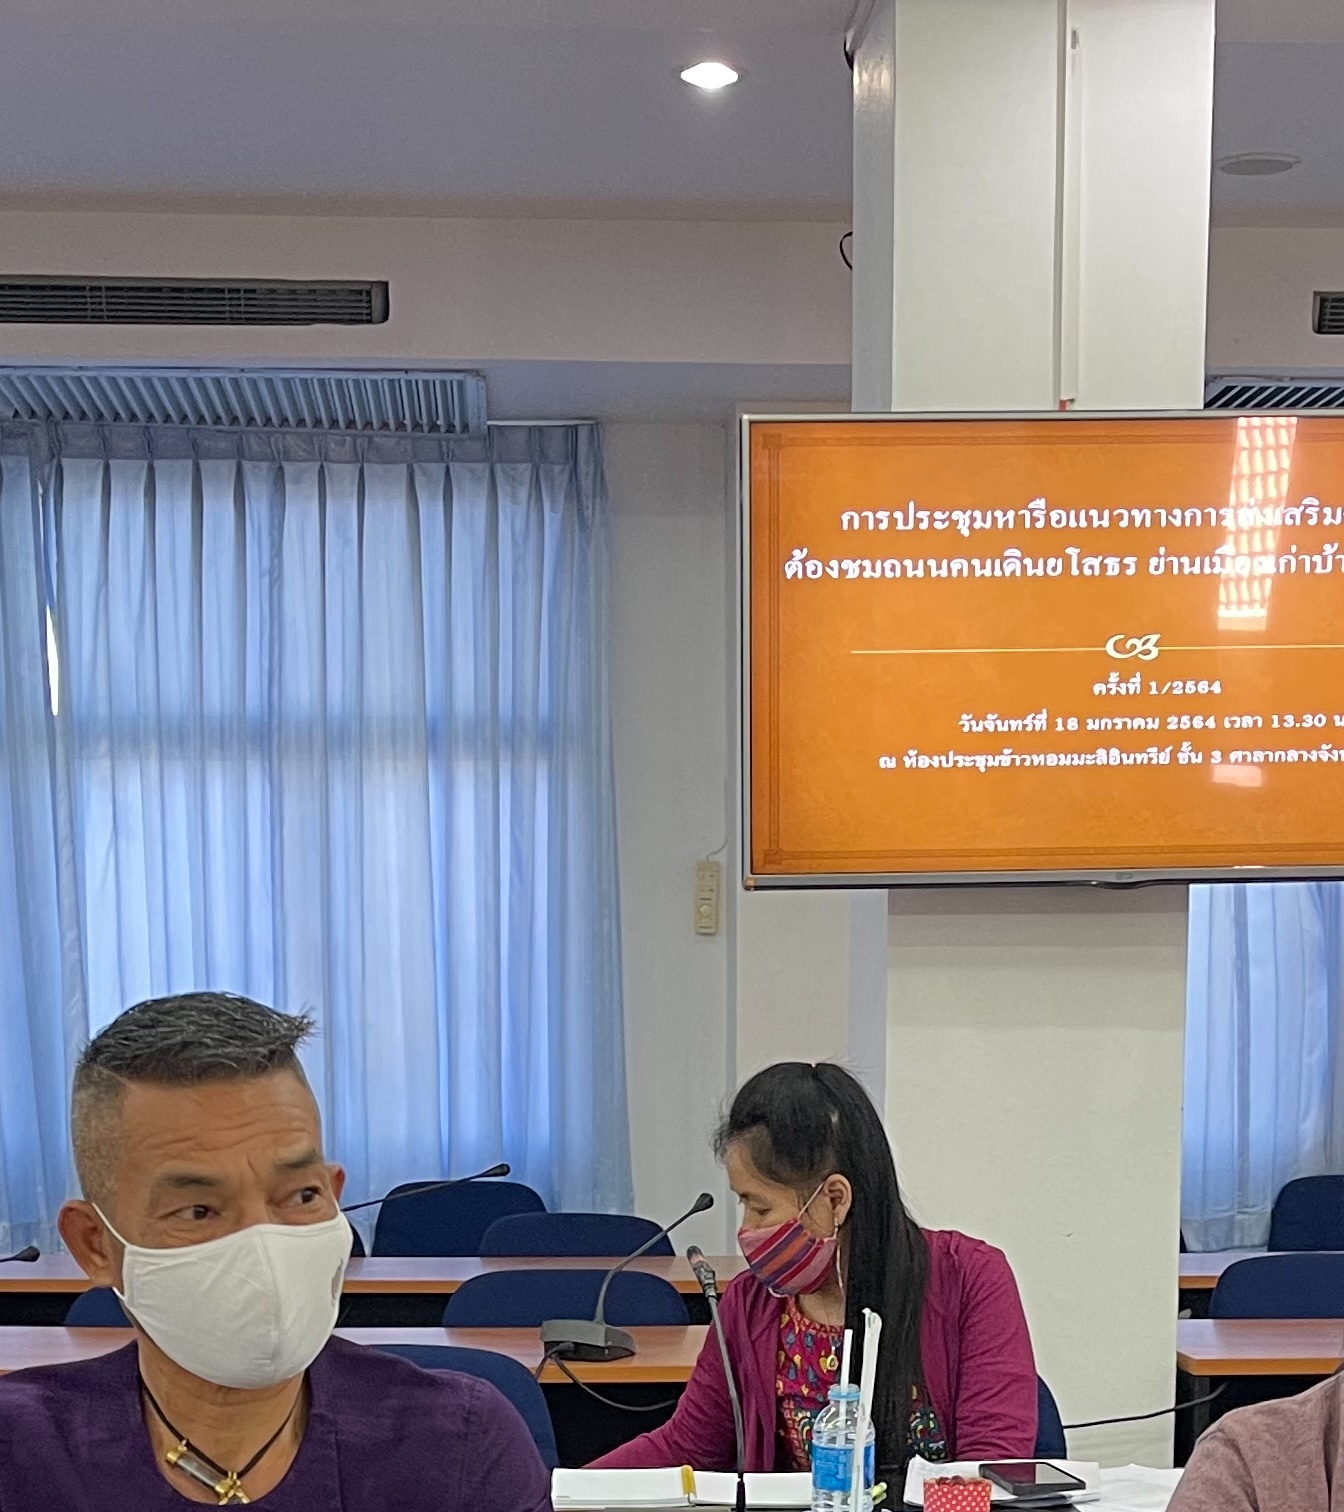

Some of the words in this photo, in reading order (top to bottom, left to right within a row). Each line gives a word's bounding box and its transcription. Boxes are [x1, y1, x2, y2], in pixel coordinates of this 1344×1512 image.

[1092, 672, 1142, 696] ครั้งที่
[1148, 680, 1223, 695] 1/2564
[958, 709, 1048, 733] วันจันทร์ที่
[1054, 716, 1080, 731] 18
[1086, 715, 1160, 731] มกราคม
[1166, 715, 1217, 730] 2564
[1223, 715, 1263, 729] เวลา
[1271, 713, 1327, 728] 13.30
[878, 755, 897, 769] ณ
[1177, 741, 1203, 764] ชั้น
